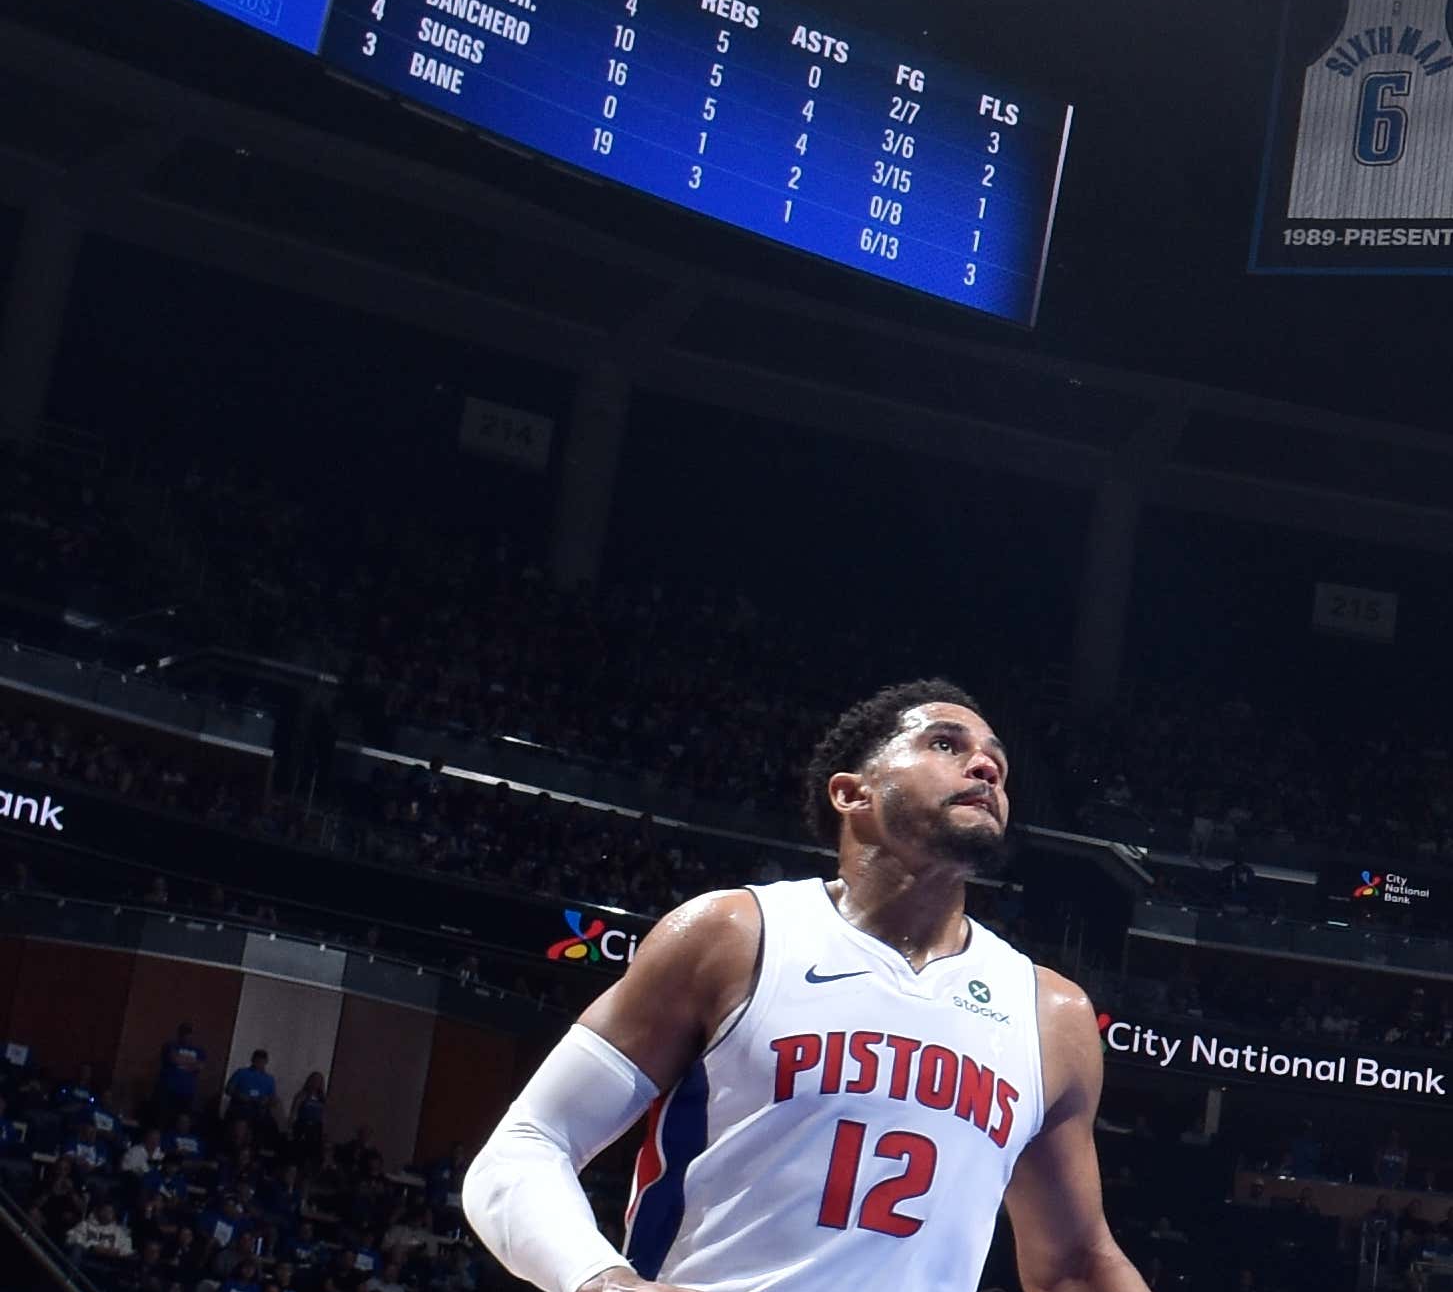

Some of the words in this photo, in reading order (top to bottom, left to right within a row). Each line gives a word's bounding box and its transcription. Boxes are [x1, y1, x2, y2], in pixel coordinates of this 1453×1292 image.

[417, 17, 486, 65] SUGGS
[1325, 26, 1393, 79] SIXTH
[409, 52, 465, 95] BANE
[791, 25, 850, 64] ASTS
[895, 65, 926, 94] FG
[978, 94, 1020, 127] FLS
[1352, 70, 1411, 167] 6
[871, 160, 912, 194] 3/15
[859, 228, 899, 261] 6/13
[0, 789, 64, 832] ank
[1107, 1022, 1181, 1066] City
[1190, 1035, 1346, 1083] National
[1355, 1058, 1446, 1096] Bank
[770, 1030, 1020, 1149] PISTONS
[817, 1119, 938, 1238] 12
